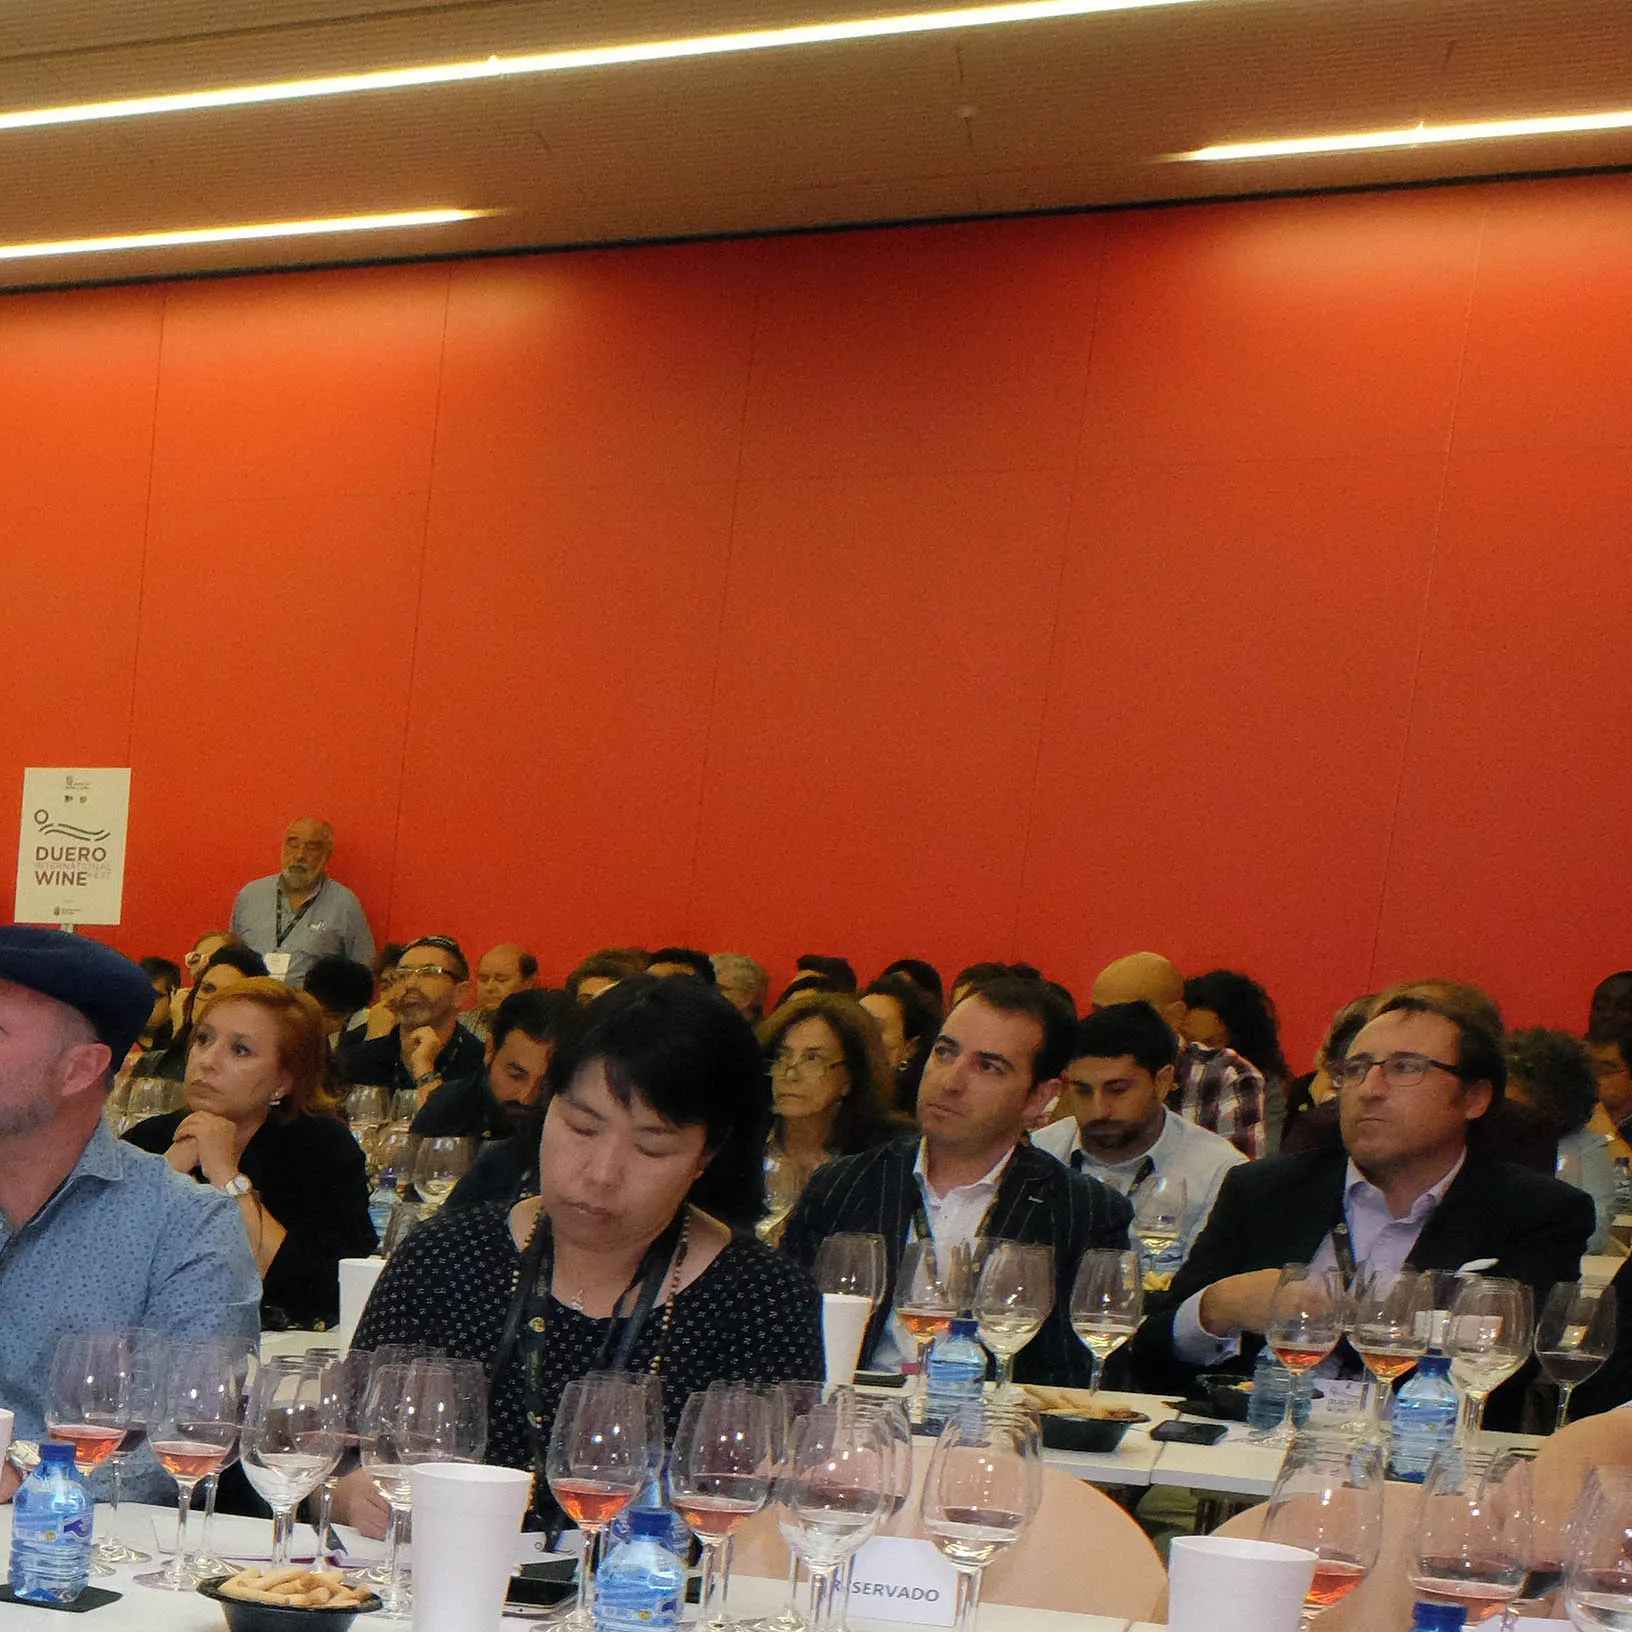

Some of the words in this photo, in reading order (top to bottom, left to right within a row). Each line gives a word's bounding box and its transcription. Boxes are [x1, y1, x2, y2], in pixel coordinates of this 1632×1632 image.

[35, 846, 107, 862] DUERO
[35, 870, 88, 886] WINE
[834, 1580, 940, 1602] RSERVADO
